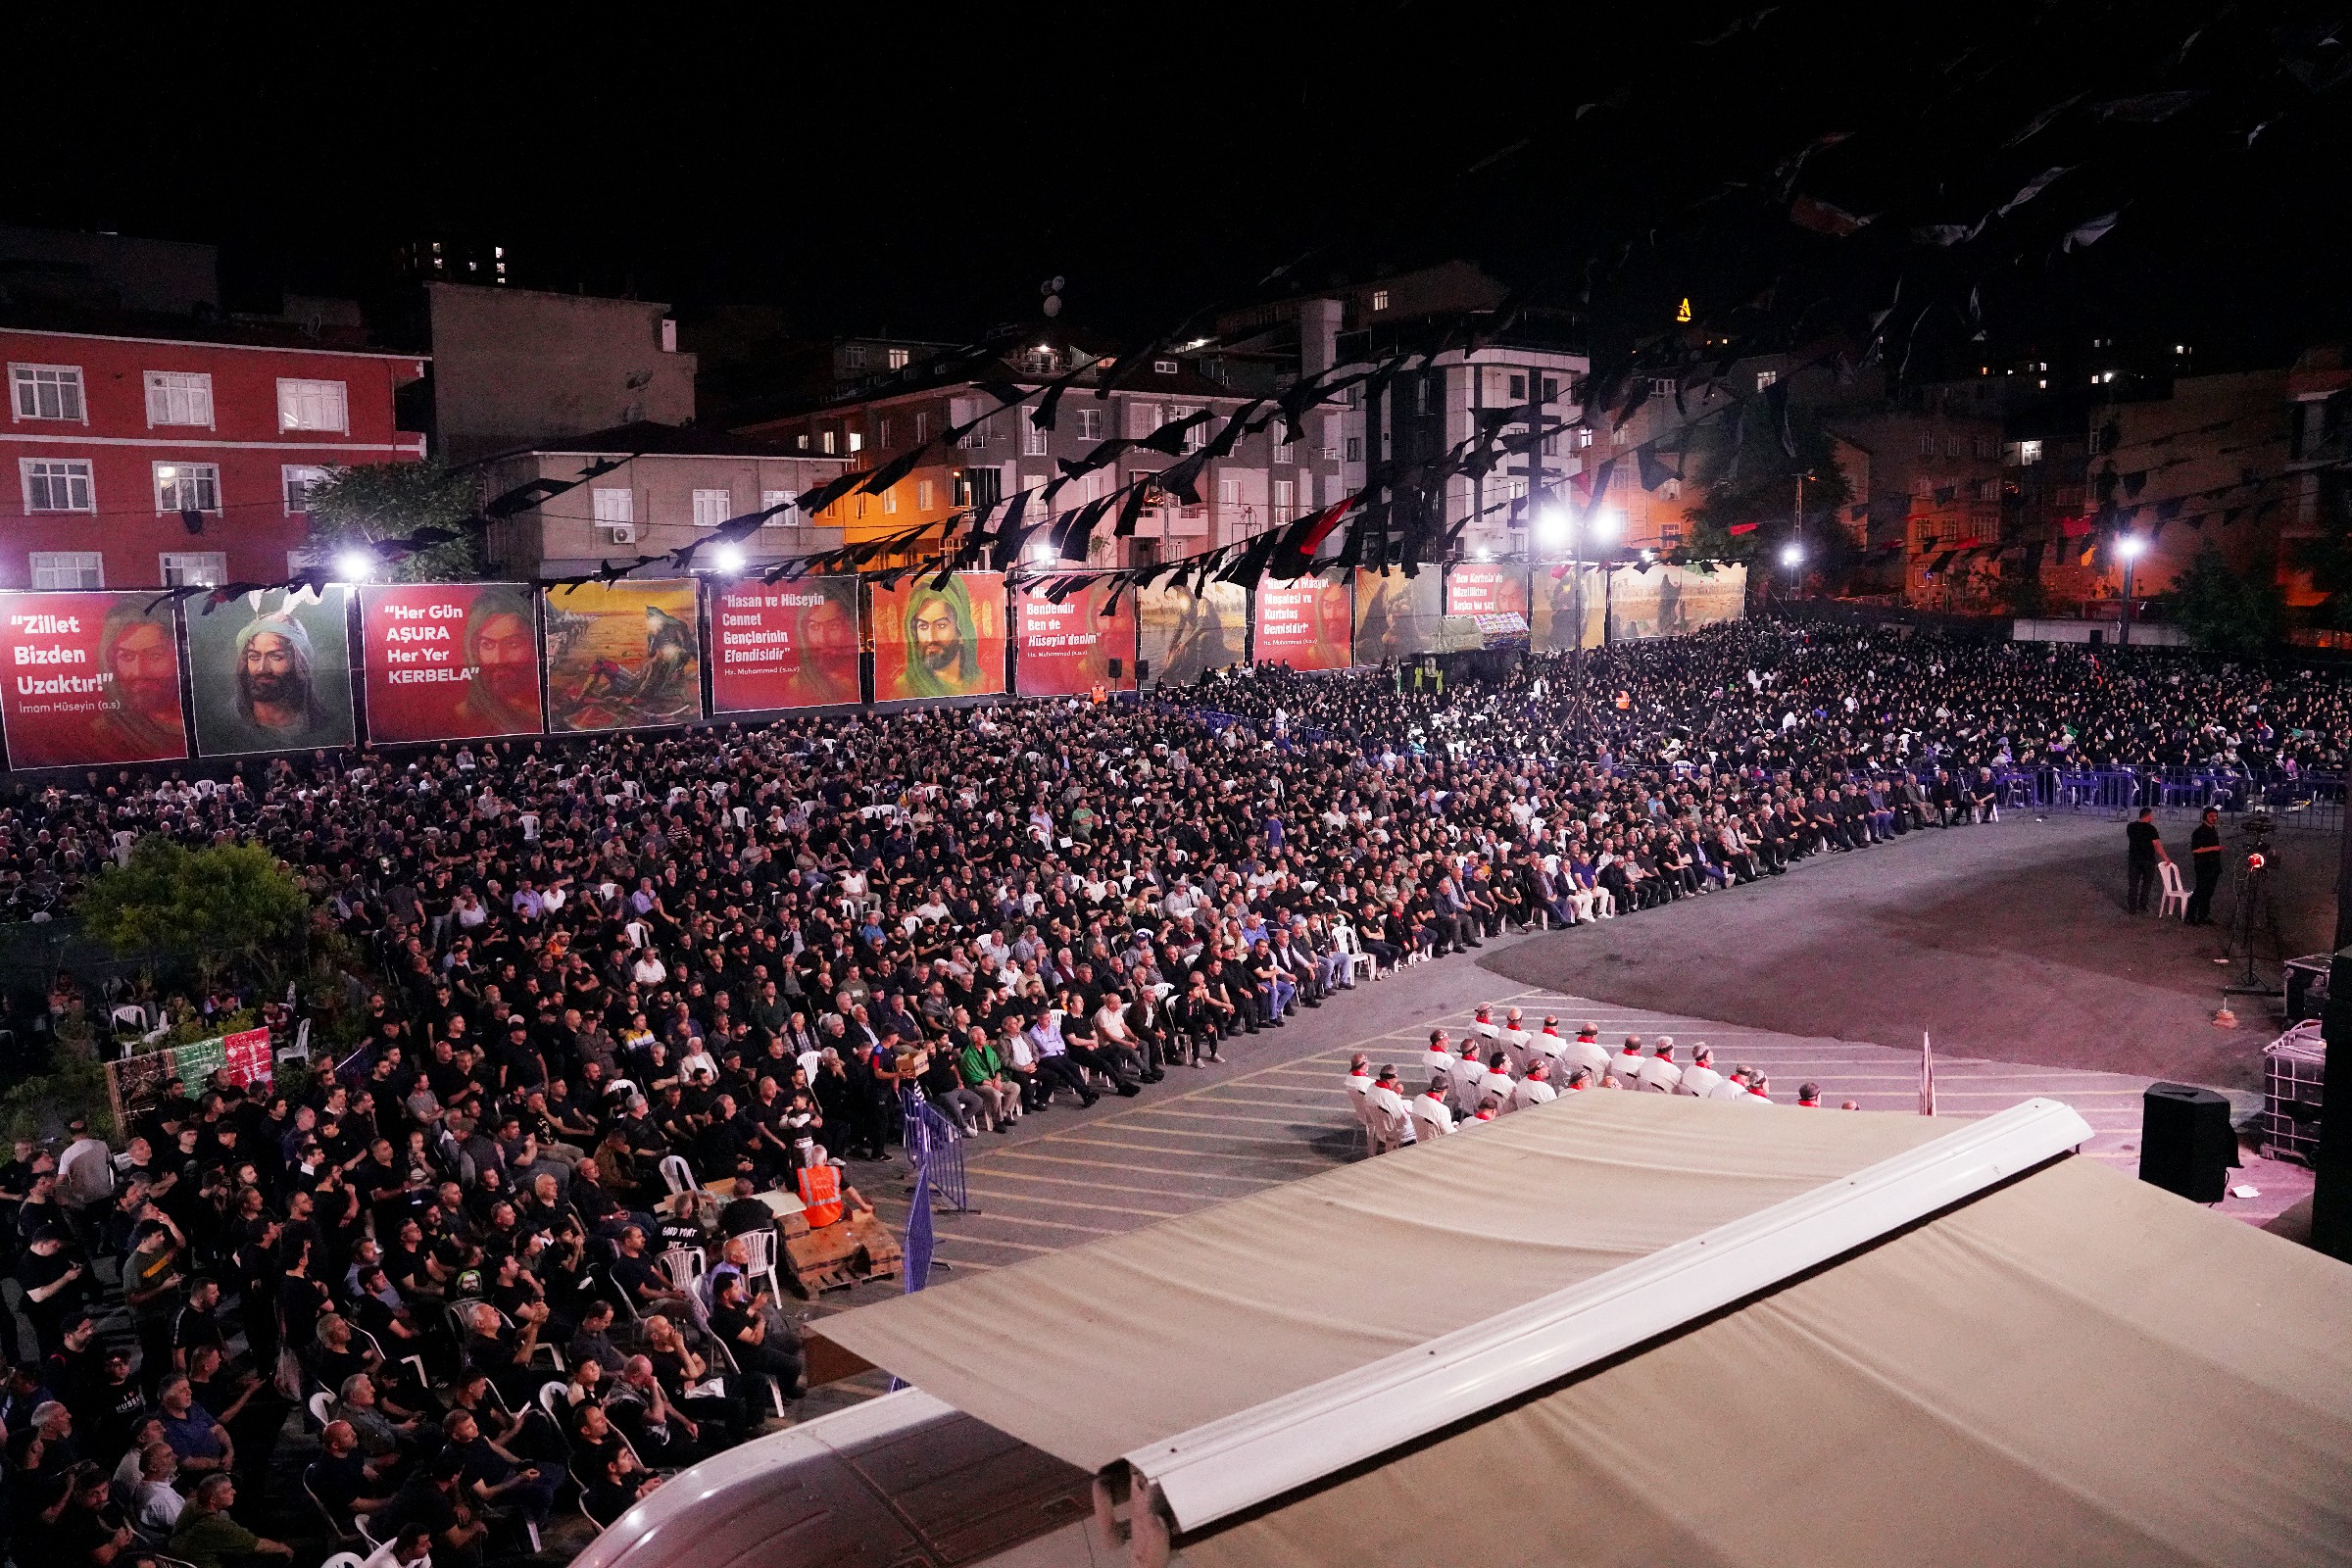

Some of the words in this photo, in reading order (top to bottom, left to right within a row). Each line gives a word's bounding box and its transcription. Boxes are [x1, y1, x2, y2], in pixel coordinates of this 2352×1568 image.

[721, 594, 762, 608] “Hasan
[765, 597, 778, 607] ve
[781, 593, 824, 608] Hüseyin
[384, 606, 425, 619] “Her
[428, 604, 464, 619] Gün
[11, 614, 80, 634] “Zillet
[722, 613, 761, 626] Cennet
[1027, 619, 1047, 631] Ben
[1049, 619, 1061, 630] de
[386, 626, 450, 643] AŞURA
[723, 629, 788, 646] Gençlerinin
[14, 644, 85, 665] Bizden
[387, 650, 418, 662] Her
[420, 648, 450, 662] Yer
[724, 648, 791, 663] Efendisidir”
[388, 667, 480, 684] KERBELA”
[737, 666, 778, 675] Muhammed
[17, 672, 114, 695] Uzaktır!”
[19, 701, 50, 713] İmam
[53, 699, 95, 712] Hüseyin
